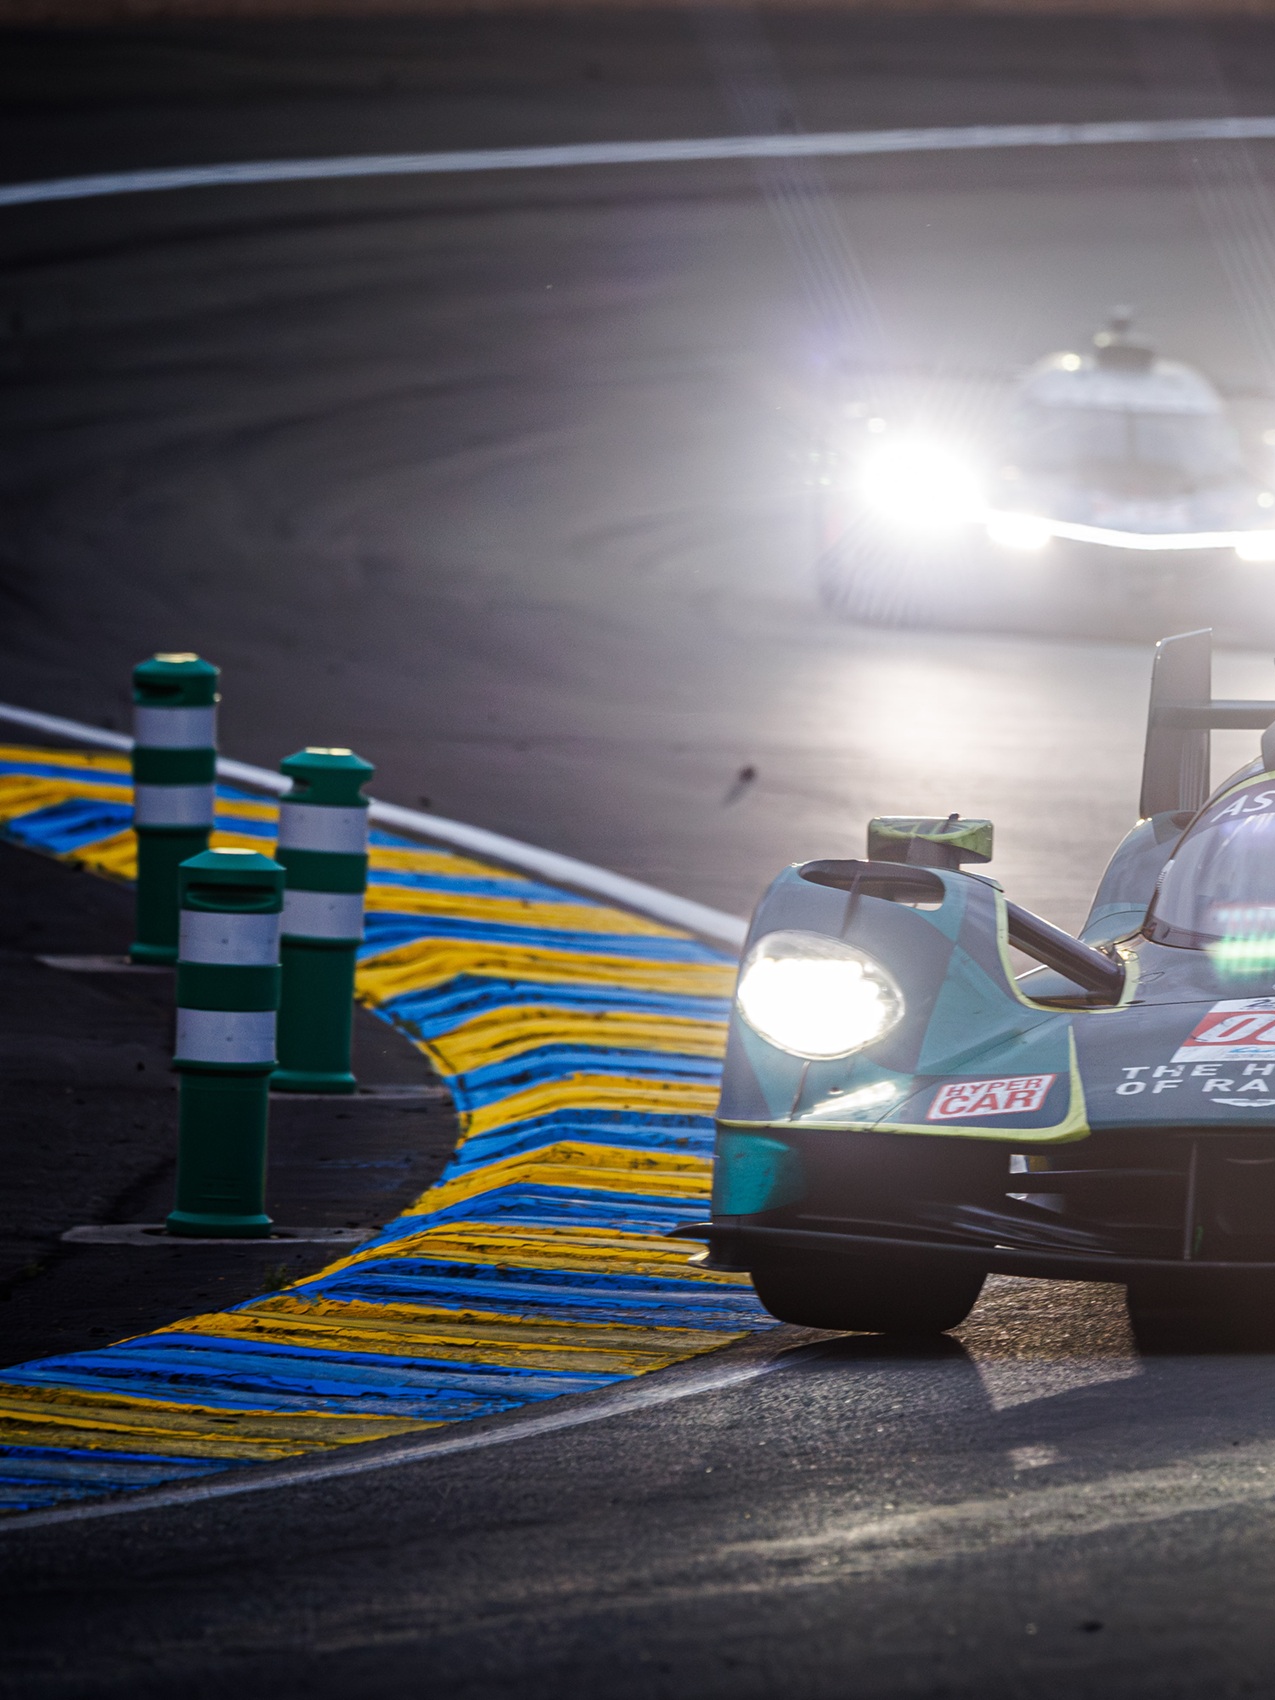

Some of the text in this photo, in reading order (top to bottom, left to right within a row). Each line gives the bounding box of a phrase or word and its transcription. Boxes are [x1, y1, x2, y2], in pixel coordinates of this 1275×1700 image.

[1121, 1063, 1222, 1079] THE
[945, 1078, 1043, 1096] HYPER
[1115, 1079, 1184, 1096] OF
[940, 1089, 1036, 1114] CAR
